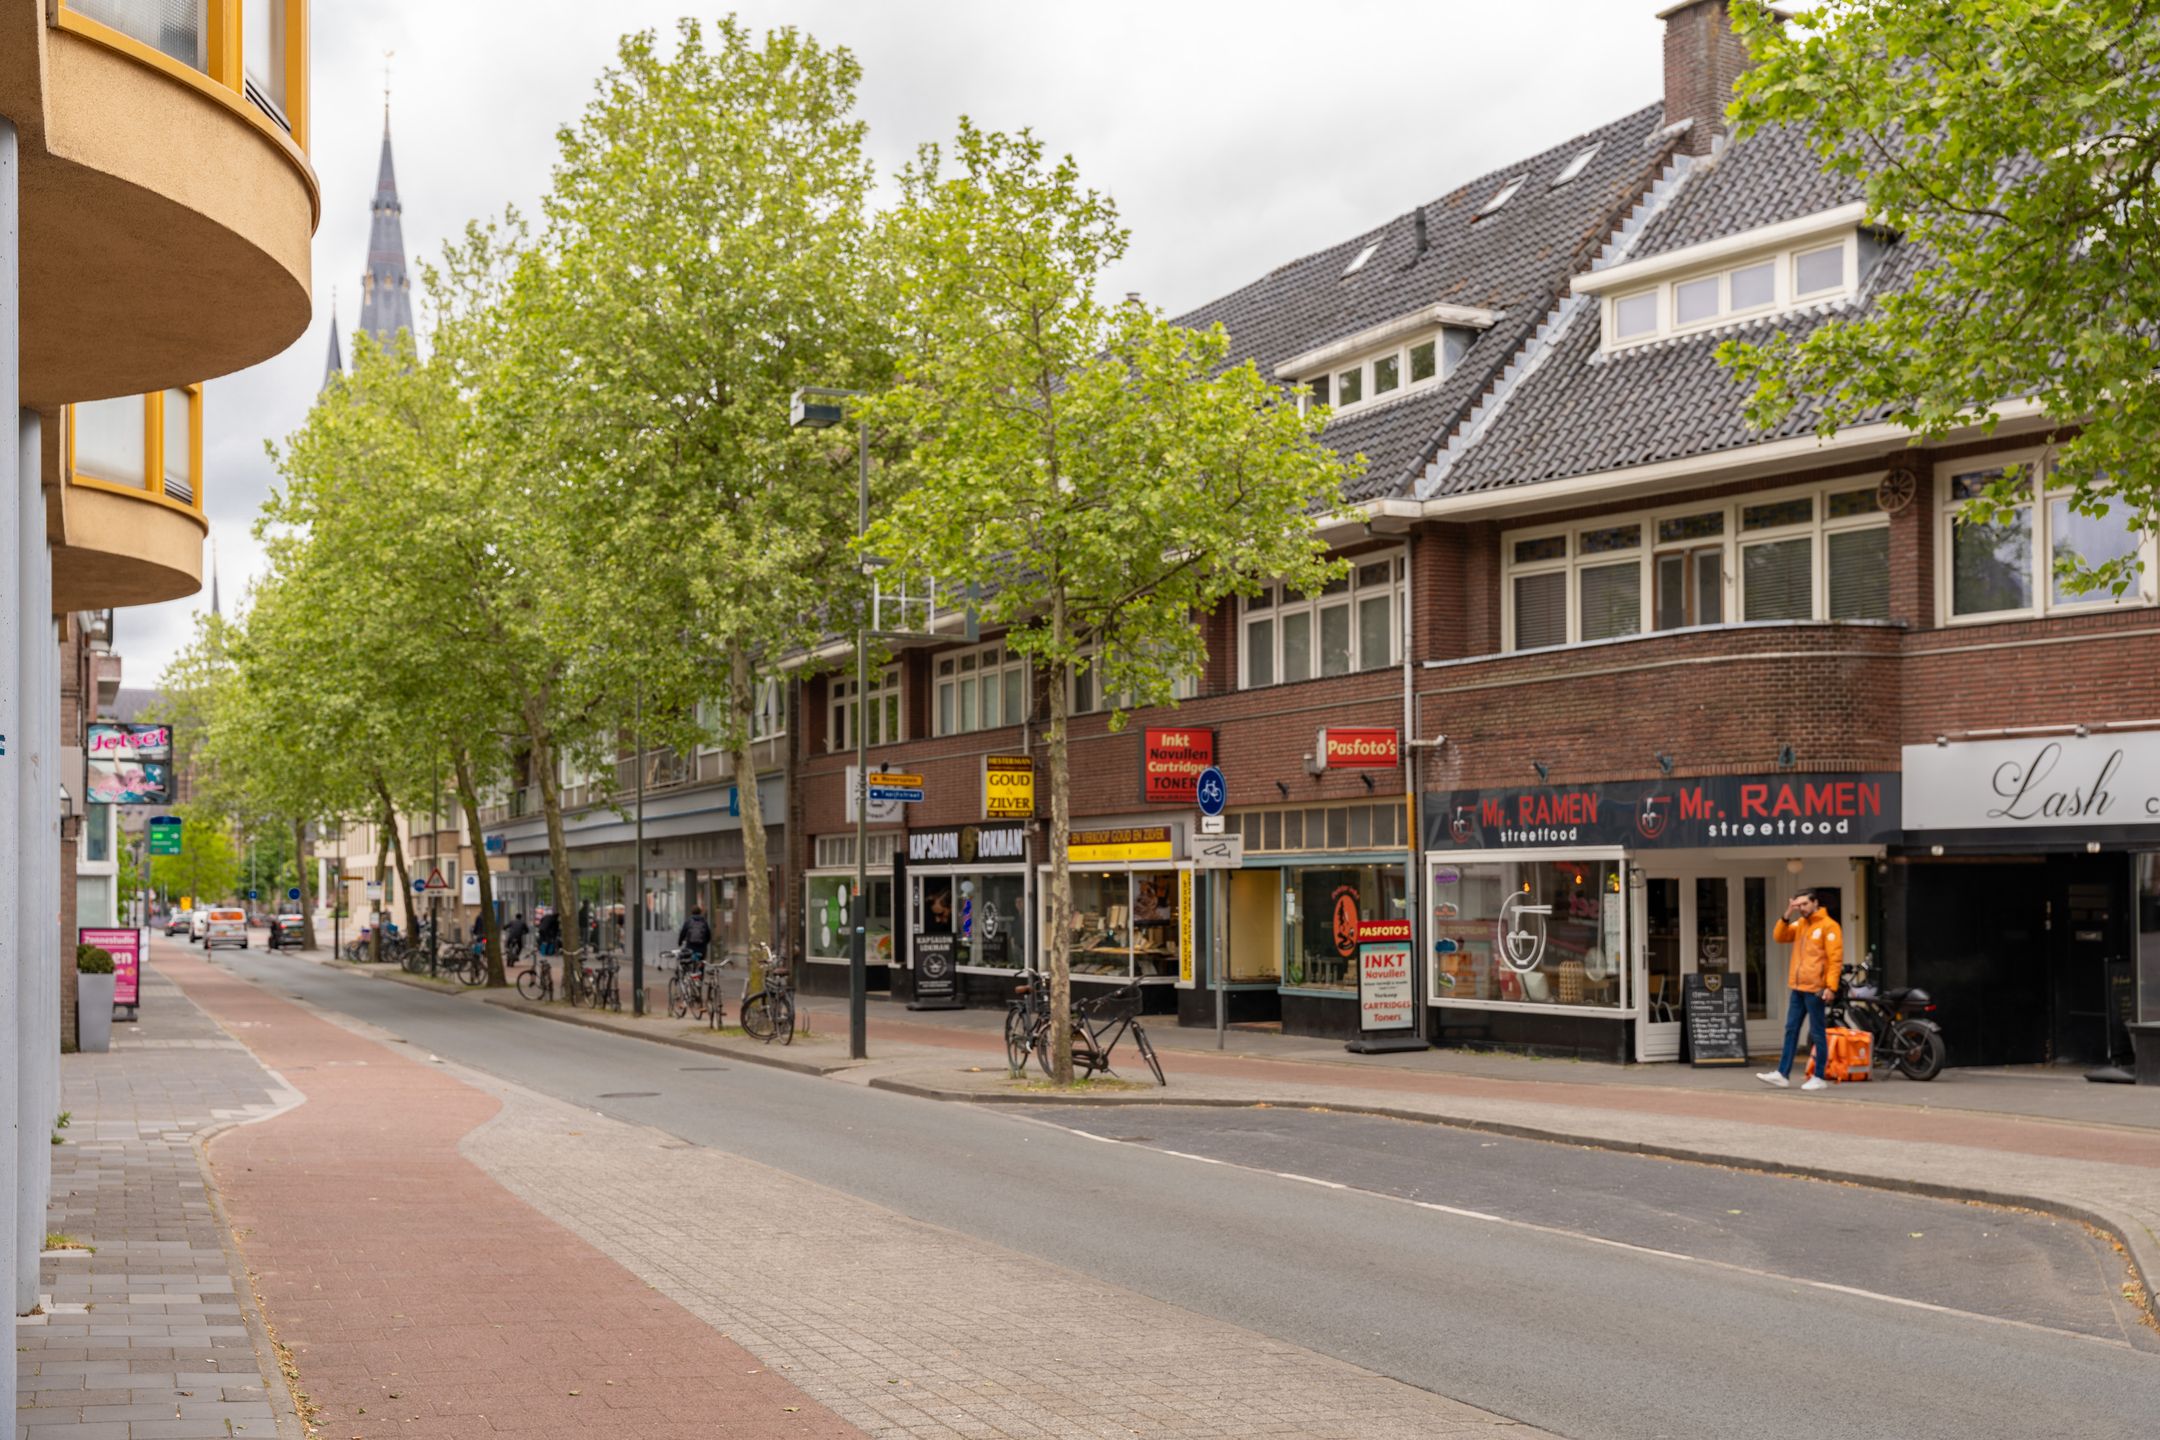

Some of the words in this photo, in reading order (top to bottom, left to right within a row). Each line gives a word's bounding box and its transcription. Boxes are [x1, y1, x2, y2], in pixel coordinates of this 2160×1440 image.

[91, 727, 169, 752] Jetset
[1161, 733, 1190, 746] Inkt
[1150, 748, 1208, 760] Navullen
[1327, 738, 1396, 756] Pasfoto's
[989, 774, 1030, 786] GOUD
[1987, 742, 2124, 820] Lash
[988, 797, 1030, 808] ZILVER
[1679, 786, 1726, 820] Mr.
[1740, 782, 1880, 818] RAMEN
[1482, 798, 1512, 827] Mr.
[1519, 792, 1598, 825] RAMEN
[1111, 830, 1131, 842] GOUD
[1132, 829, 1142, 841] EN
[1143, 828, 1165, 840] ZILVER
[1500, 827, 1577, 842] streetfood
[1708, 819, 1848, 837] streetfood
[909, 832, 958, 860] KAPSALON
[978, 828, 1023, 858] LOKMAN
[1359, 926, 1409, 937] PASFOTO'S
[916, 936, 953, 944] KAPSALON
[1364, 953, 1406, 969] INKT
[1365, 969, 1406, 979] Navullen
[1363, 1001, 1411, 1010] CARTRIDGES
[1374, 1014, 1402, 1022] Toners
